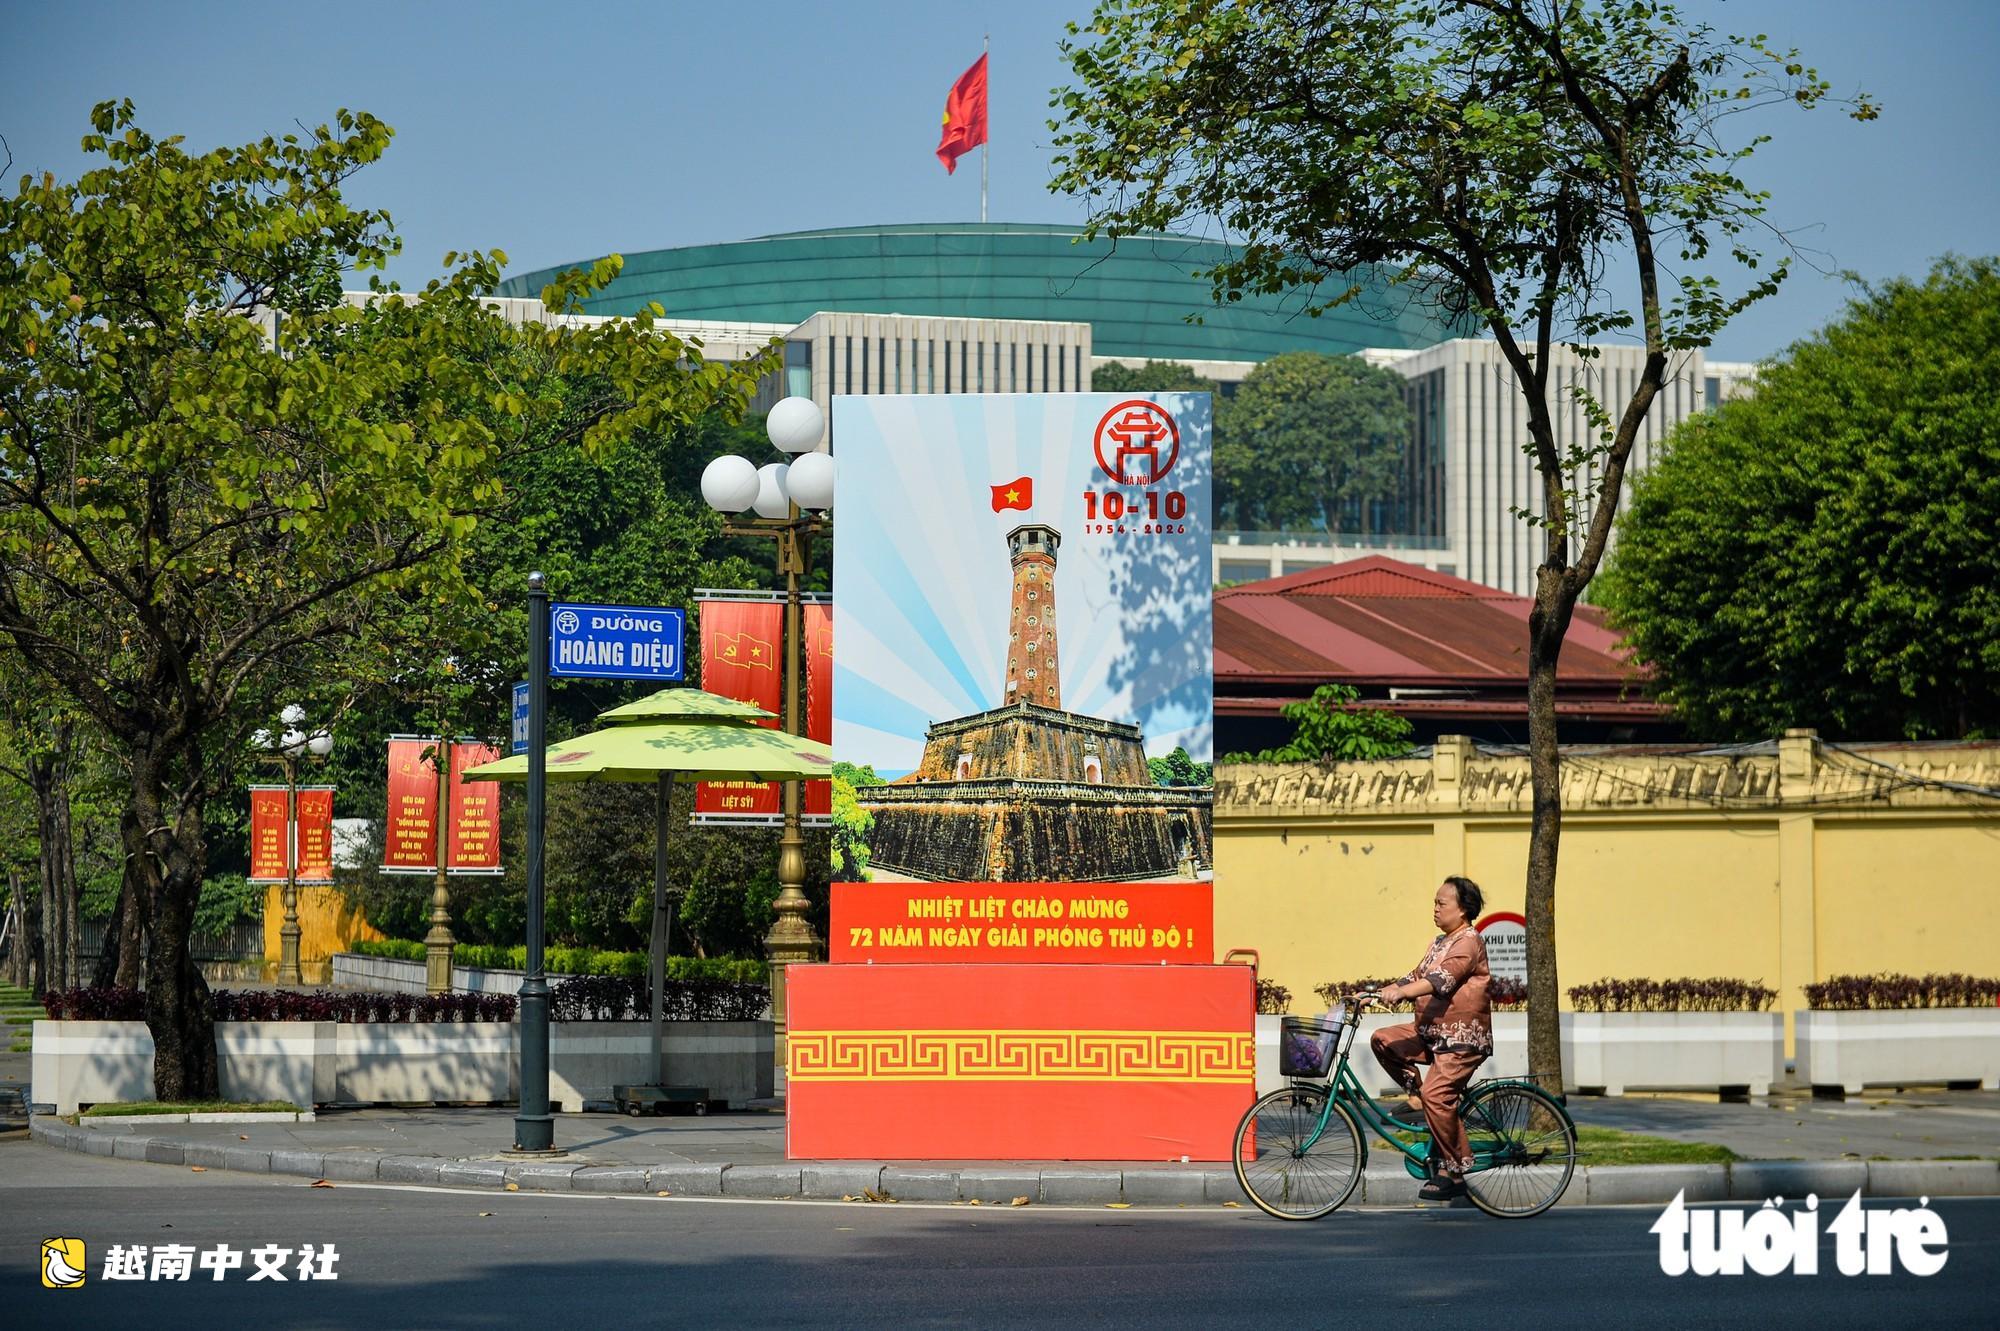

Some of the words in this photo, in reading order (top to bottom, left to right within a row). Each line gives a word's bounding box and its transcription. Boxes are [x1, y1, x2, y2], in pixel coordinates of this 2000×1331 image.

[1083, 491, 1186, 520] 10-10
[591, 614, 663, 632] ĐƯỜNG
[559, 635, 624, 666] HOÀNG
[631, 639, 674, 672] DIỆU
[414, 797, 425, 805] CAO
[721, 795, 739, 809] LIỆT
[908, 896, 963, 922] NHIỆT
[969, 896, 1005, 922] LIỆT
[1011, 895, 1063, 918] CHÀO
[1069, 896, 1129, 919] MỪNG
[850, 928, 872, 947] 72
[879, 925, 923, 947] NĂM
[929, 924, 982, 947] NGÀY
[987, 923, 1027, 947] GIẢI
[1034, 924, 1103, 947] PHÓNG
[1109, 922, 1144, 947] THỦ
[1152, 924, 1179, 947] ĐÔ
[1187, 928, 1193, 947] !
[1485, 935, 1504, 945] KHU
